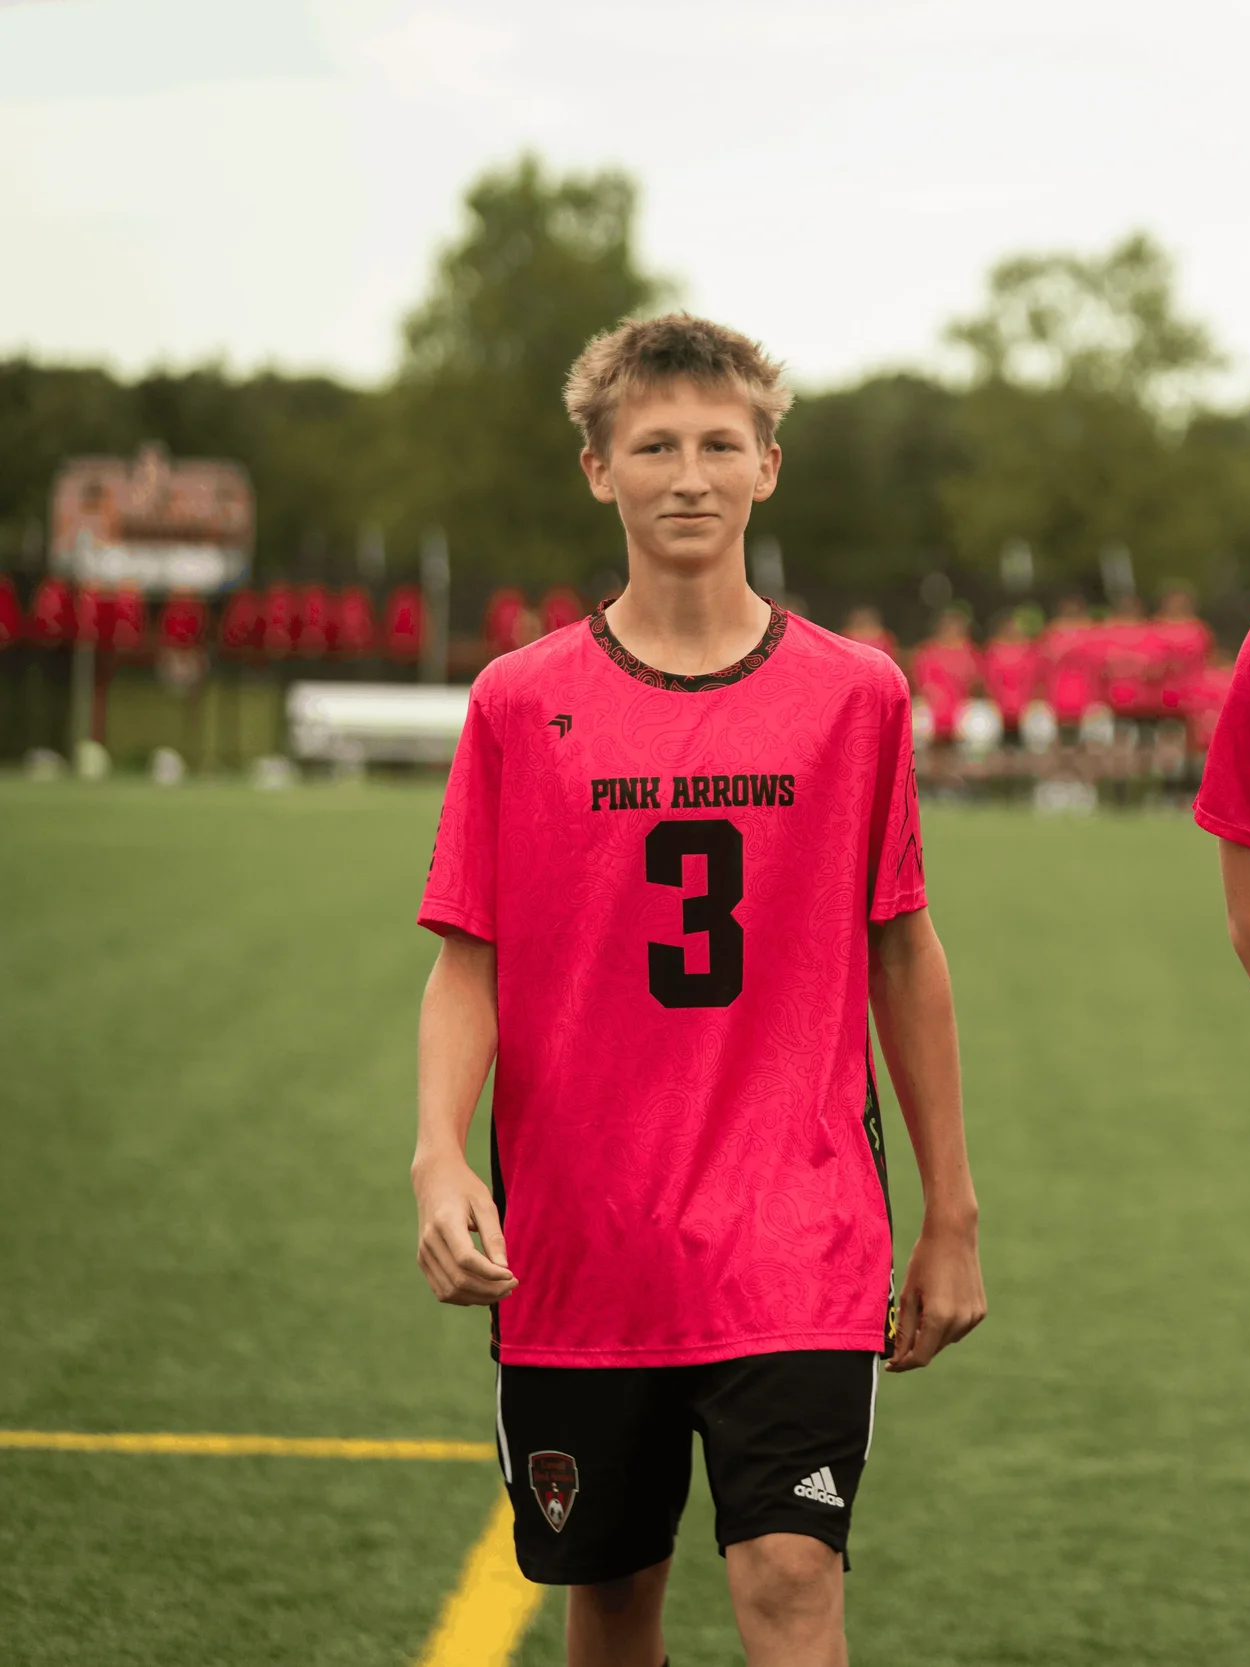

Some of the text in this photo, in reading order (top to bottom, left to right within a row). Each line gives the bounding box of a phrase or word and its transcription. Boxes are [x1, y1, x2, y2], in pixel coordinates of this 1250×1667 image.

[591, 774, 795, 811] PINK ARROWS
[645, 818, 744, 1009] 3
[793, 1484, 845, 1508] adidas
